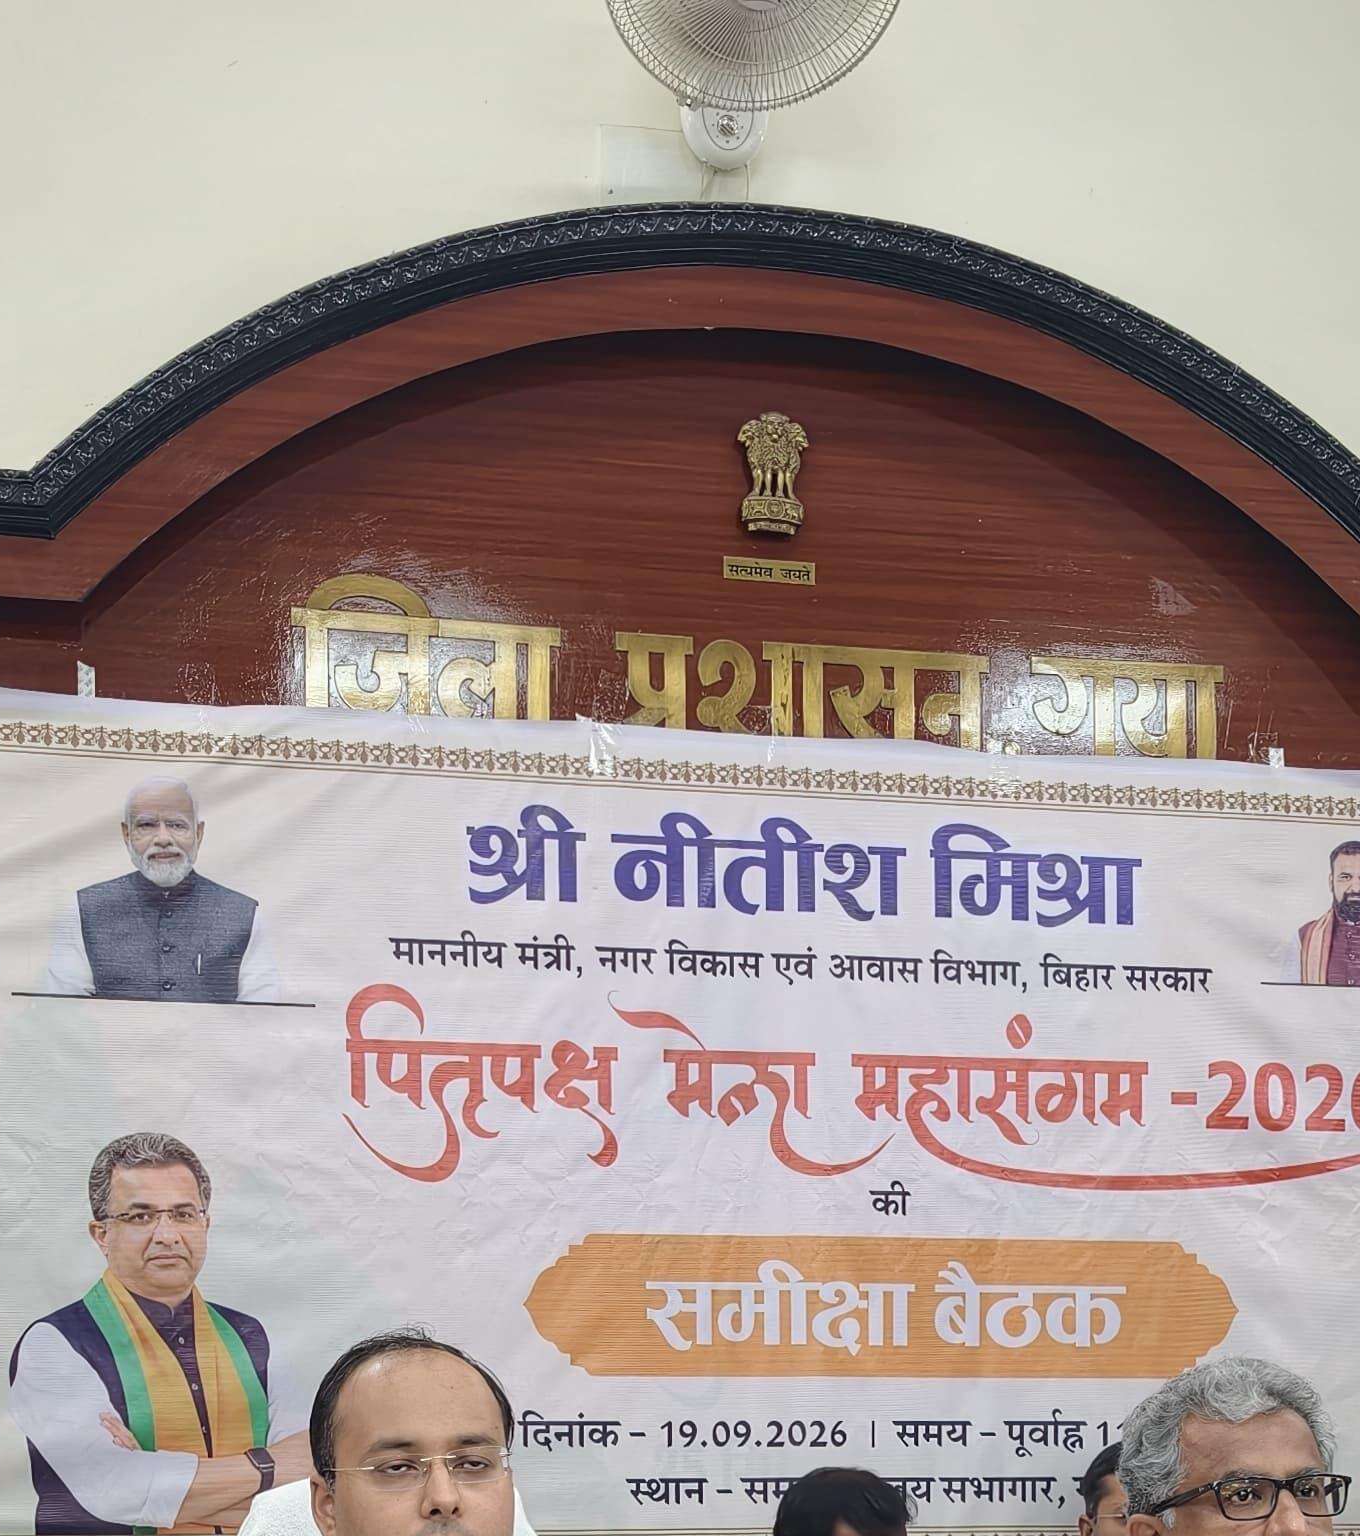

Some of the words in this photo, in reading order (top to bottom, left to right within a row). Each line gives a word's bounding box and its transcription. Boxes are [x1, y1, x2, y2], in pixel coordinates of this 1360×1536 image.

[727, 562, 773, 578] सत्यमेव
[779, 566, 812, 581] जयते
[291, 573, 561, 720] जिला
[1030, 655, 1224, 760] गया
[466, 804, 586, 905] श्री
[611, 812, 906, 921] नीतीश
[930, 823, 1142, 928] मिश्रा
[389, 930, 507, 968] माननीय
[515, 934, 582, 977] मंत्री,
[595, 946, 656, 974] नगर
[665, 939, 764, 977] विकास
[772, 947, 817, 985] एवं
[829, 955, 922, 983] आवास
[930, 949, 1027, 993] विभाग,
[1039, 953, 1115, 990] बिहार
[1123, 965, 1212, 993] सरकार
[343, 983, 619, 1182] पितृपक्ष
[608, 990, 890, 1177] मेला
[851, 1014, 1200, 1191] महासंगम
[870, 1181, 911, 1216] की
[646, 1259, 916, 1356] समीक्षा
[935, 1260, 1127, 1348] बैठक
[517, 1410, 621, 1451] दिनांक
[660, 1420, 847, 1449] 19.09.2026
[892, 1420, 973, 1448] समय
[626, 1477, 709, 1505] स्थान
[939, 1476, 1066, 1509] सभागार,
